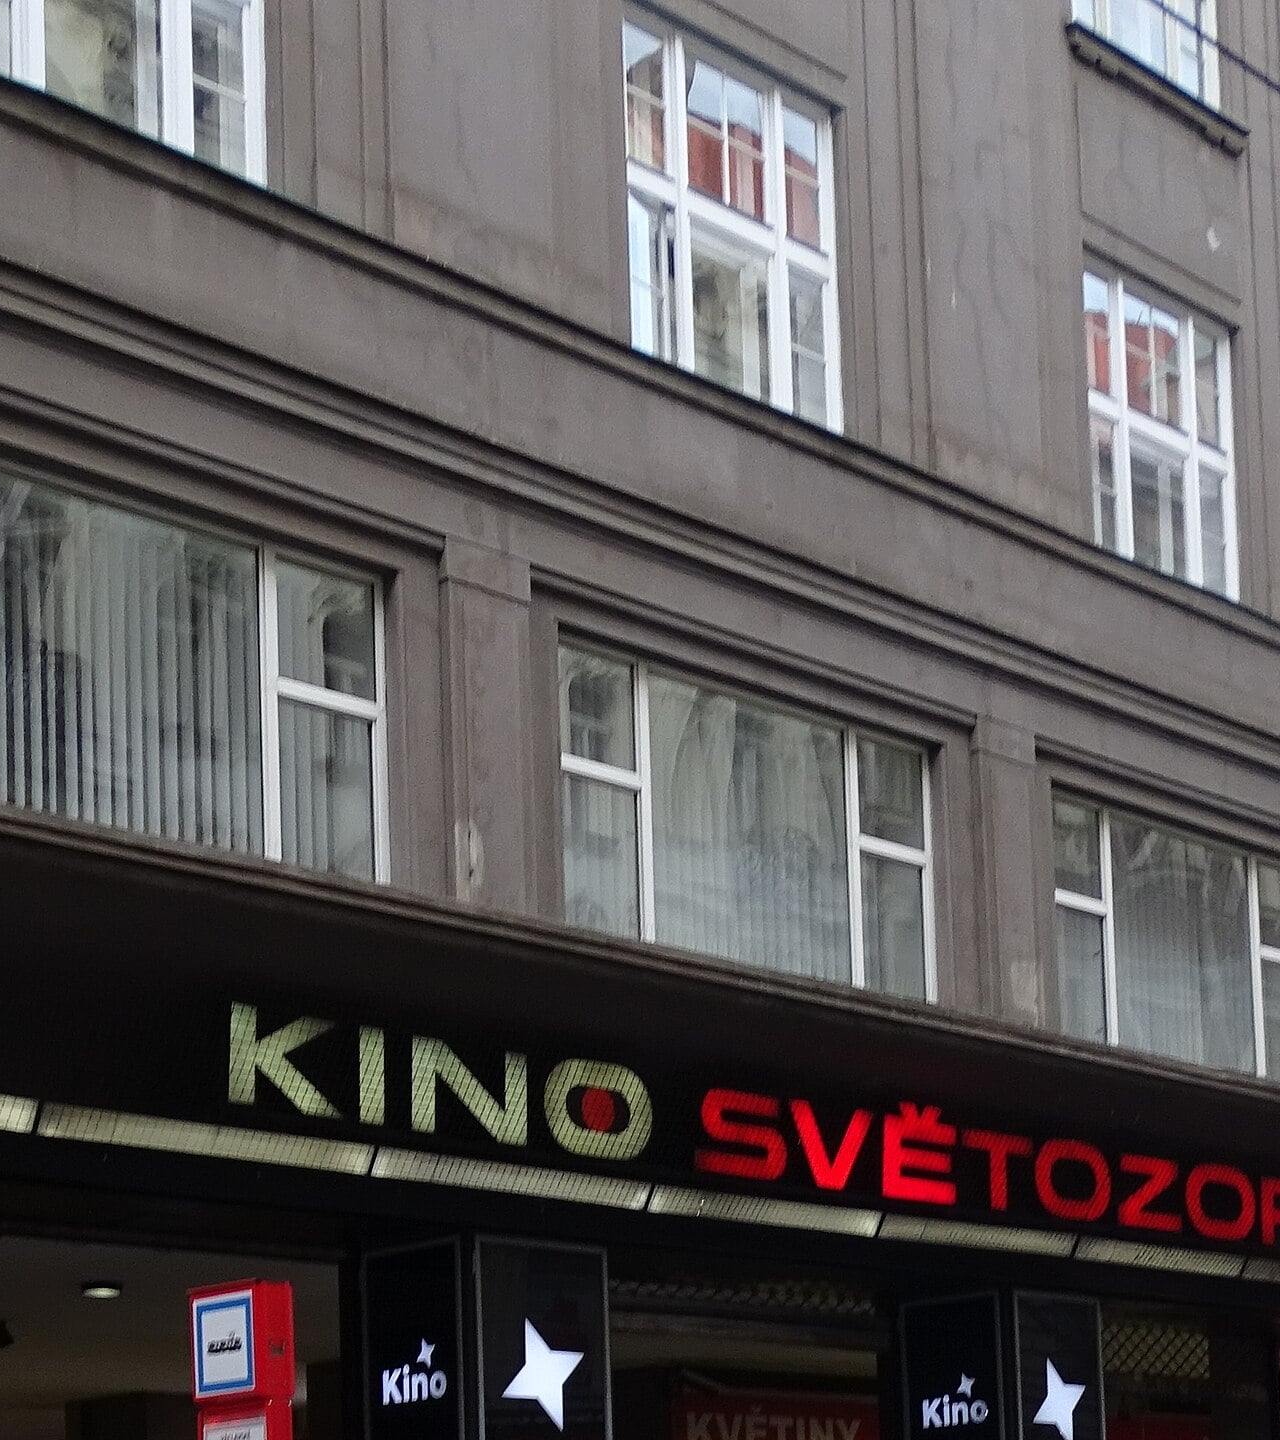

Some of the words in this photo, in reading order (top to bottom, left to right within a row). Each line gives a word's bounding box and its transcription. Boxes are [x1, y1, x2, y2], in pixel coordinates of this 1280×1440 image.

[229, 1002, 653, 1162] KINO
[382, 1363, 447, 1406] Kino
[922, 1394, 988, 1430] Kino
